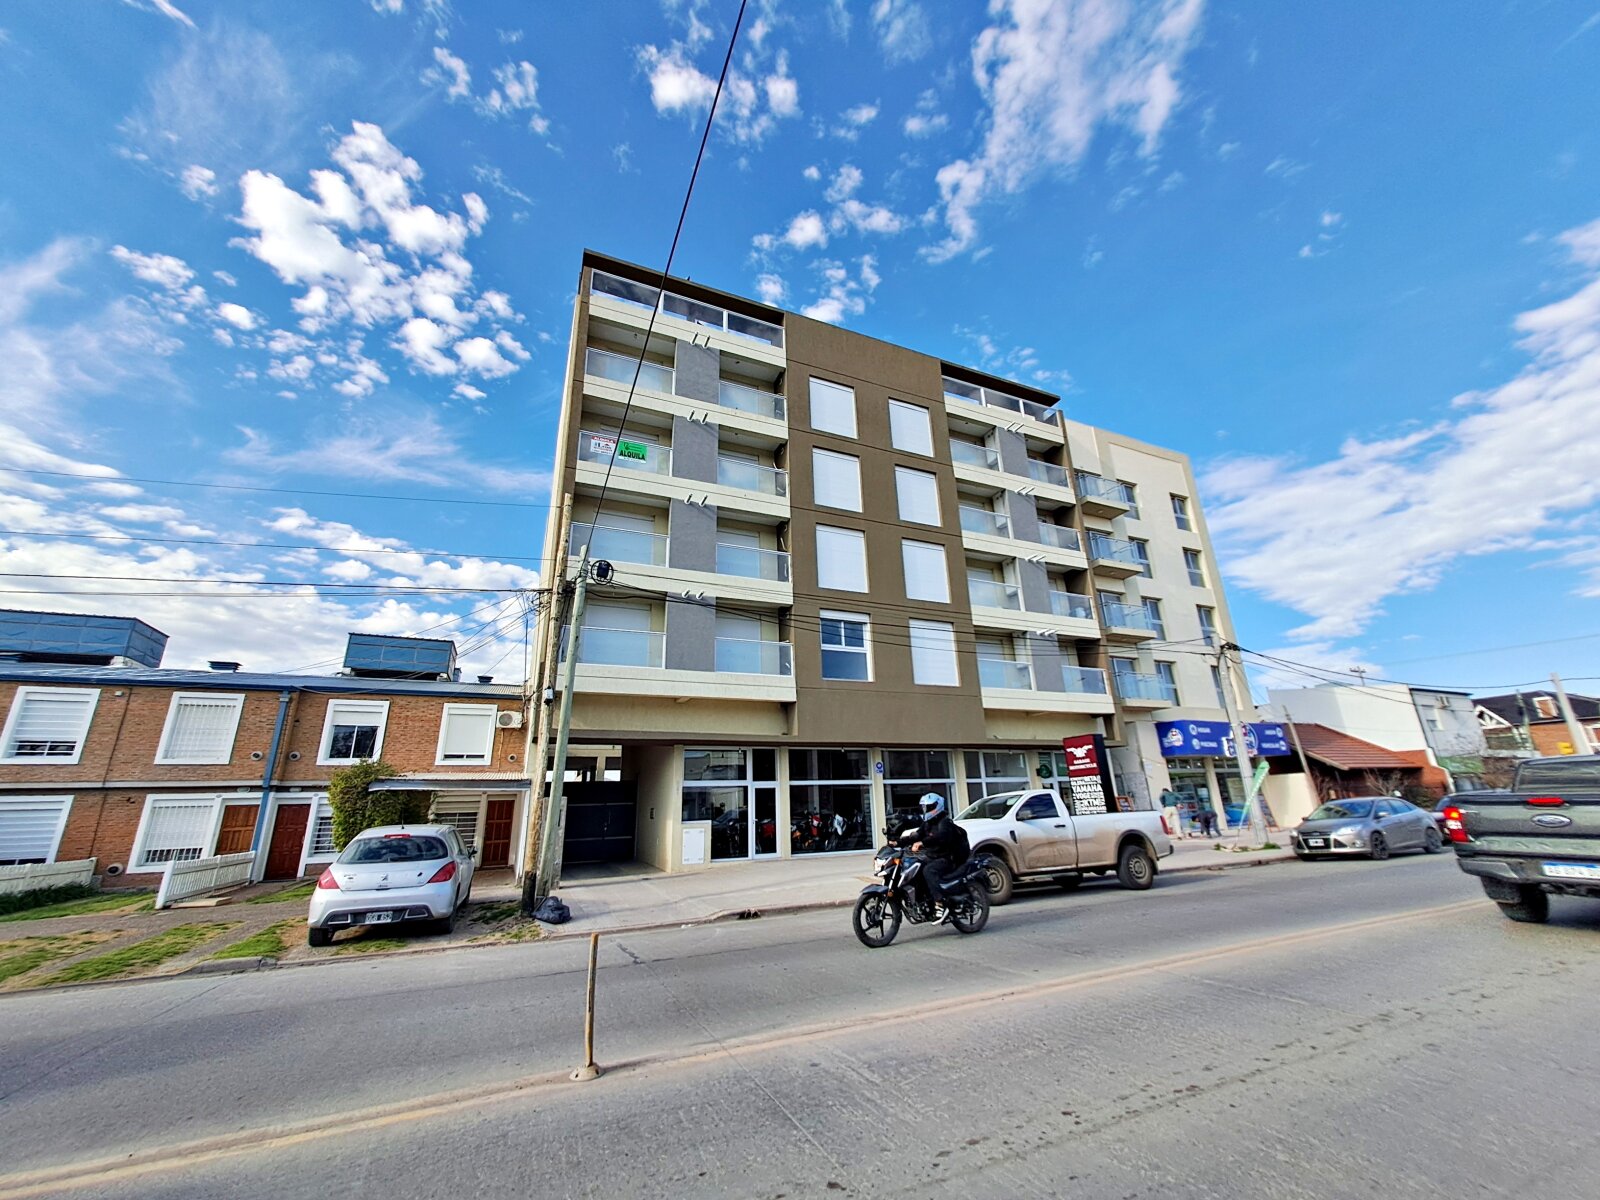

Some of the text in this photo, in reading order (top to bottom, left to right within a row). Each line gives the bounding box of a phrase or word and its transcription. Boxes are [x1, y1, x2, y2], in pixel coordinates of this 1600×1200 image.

[619, 450, 646, 461] ALQUILA
[1071, 784, 1103, 793] YAMAHA
[1083, 798, 1099, 806] KTM
